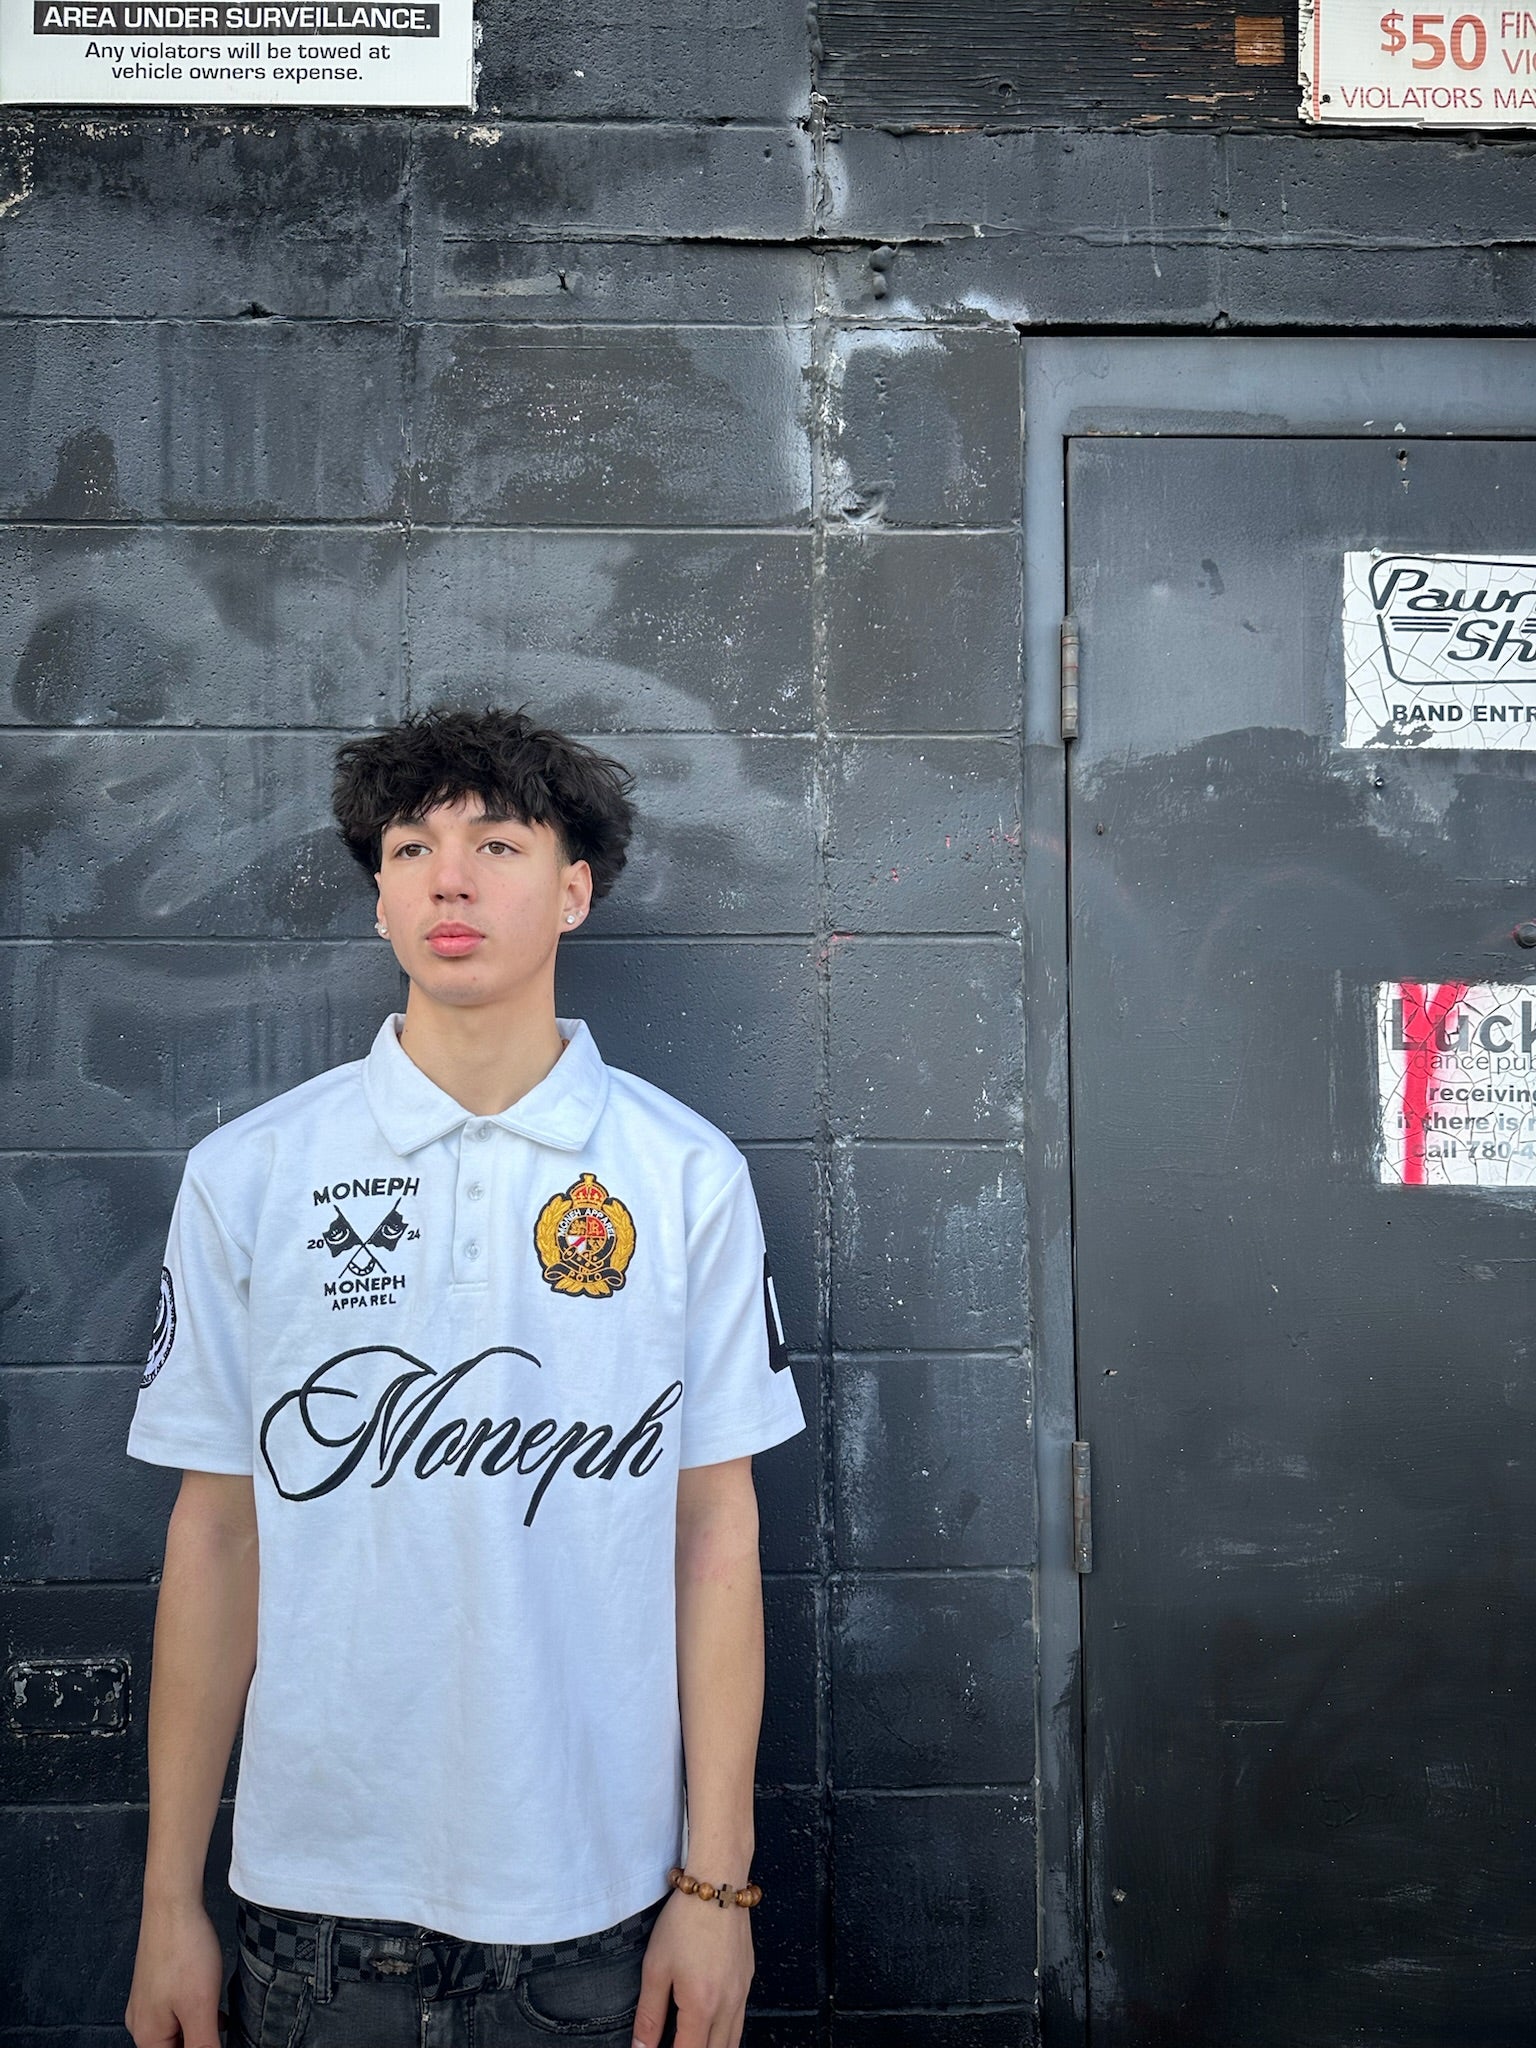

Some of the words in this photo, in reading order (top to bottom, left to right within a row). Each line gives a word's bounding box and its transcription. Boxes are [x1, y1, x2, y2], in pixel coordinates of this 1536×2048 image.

[43, 6, 117, 28] AREA
[124, 7, 219, 28] UNDER
[225, 7, 432, 31] SURVEILLANCE.
[1380, 8, 1487, 71] $50
[85, 42, 125, 62] Any
[129, 42, 221, 60] violators
[227, 42, 261, 60] will
[267, 42, 292, 60] be
[298, 43, 362, 60] towed
[369, 44, 391, 60] at
[1501, 48, 1536, 75] VI
[111, 62, 183, 80] vehicle
[189, 66, 267, 80] owners
[272, 66, 364, 84] expense.
[1340, 86, 1483, 109] VIOLATORS
[1493, 87, 1536, 109] MA
[1392, 704, 1463, 722] BAND
[1429, 1084, 1536, 1107] receivin
[1423, 1111, 1489, 1130] there
[1499, 1112, 1518, 1131] is
[313, 1177, 420, 1206] MONEPH
[307, 1239, 325, 1249] 20
[407, 1228, 421, 1241] 24
[324, 1275, 406, 1297] MONEPH
[567, 1270, 602, 1283] POLO
[332, 1293, 397, 1312] APPAREL
[260, 1345, 683, 1528] Moneph
